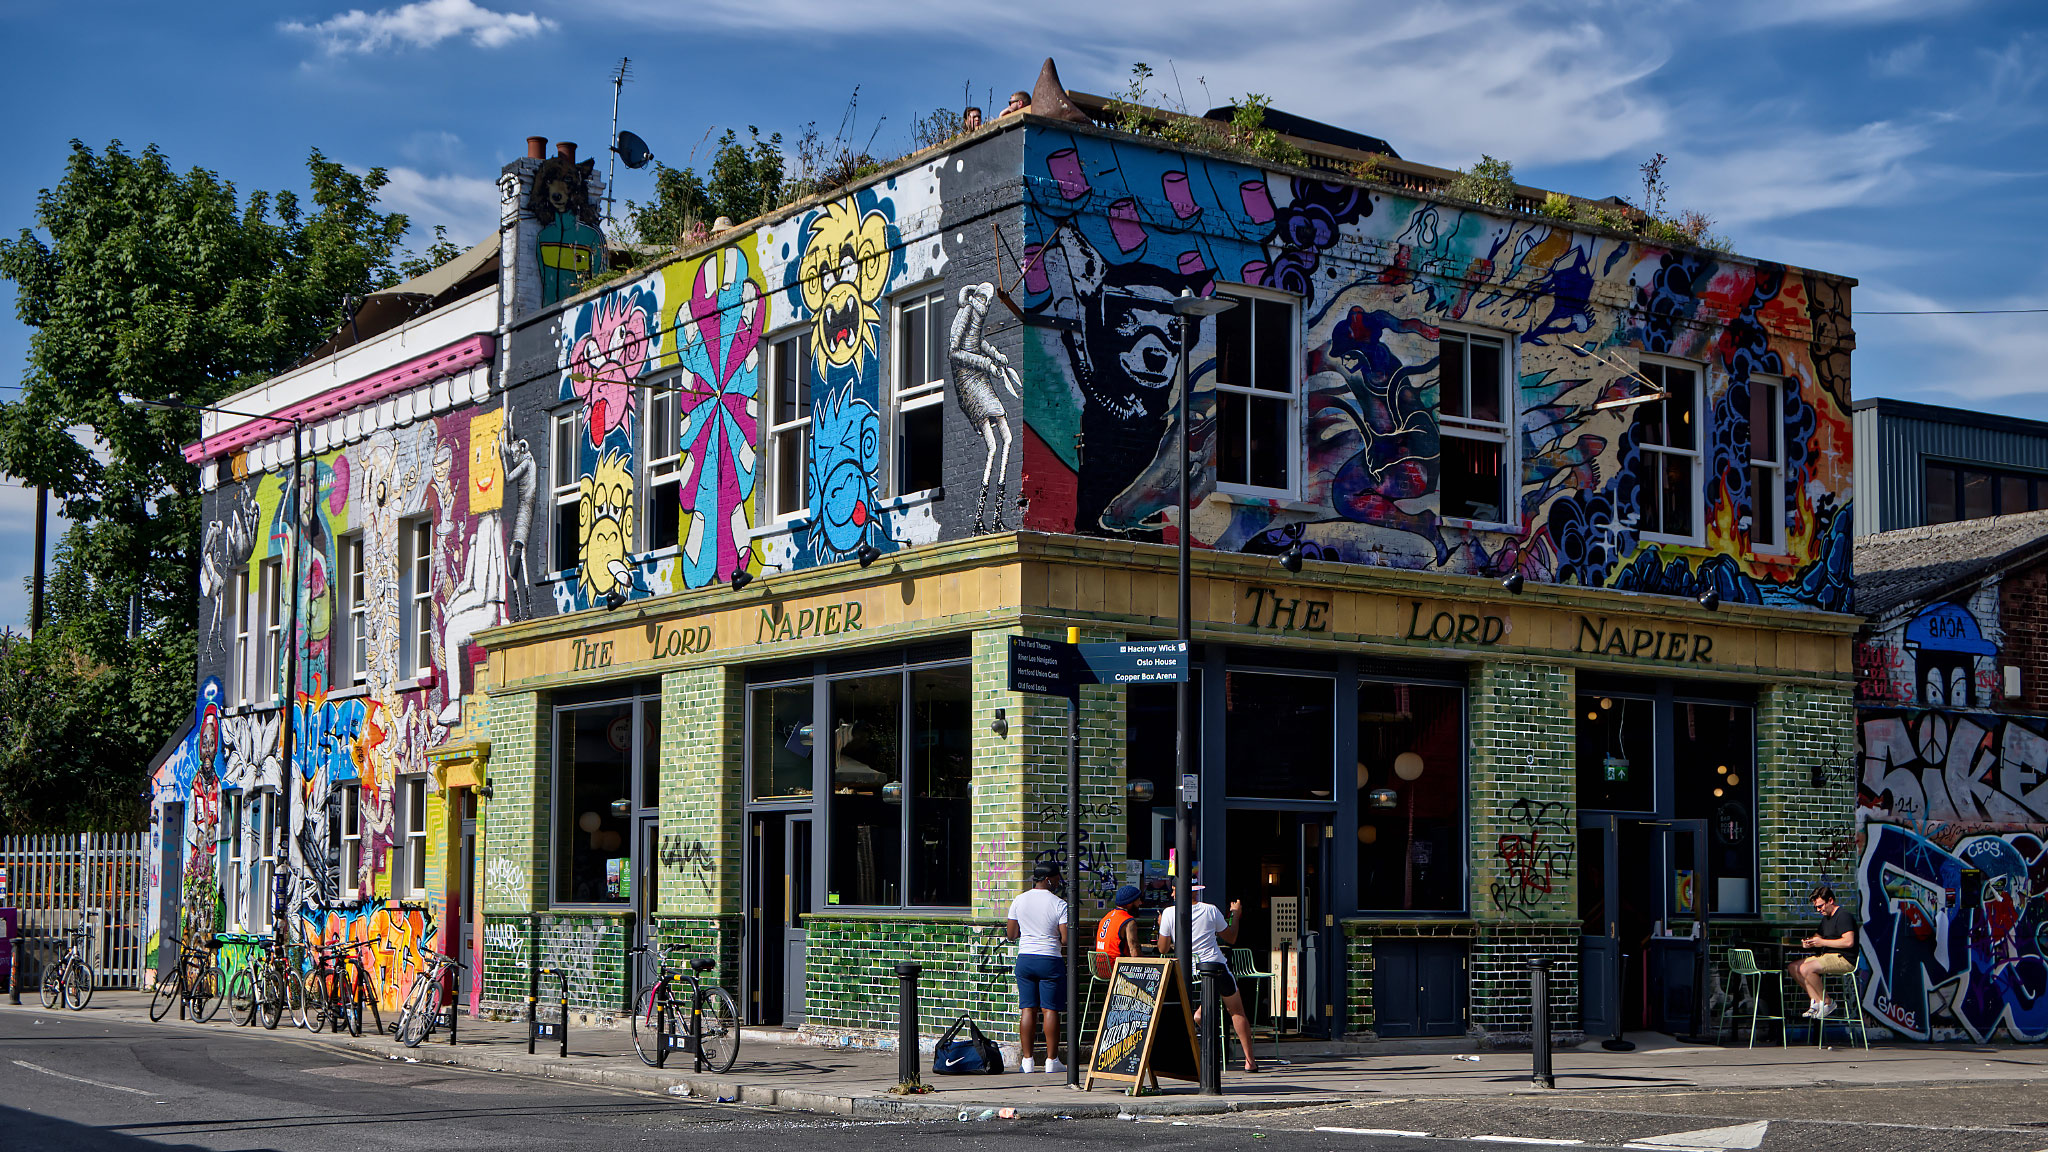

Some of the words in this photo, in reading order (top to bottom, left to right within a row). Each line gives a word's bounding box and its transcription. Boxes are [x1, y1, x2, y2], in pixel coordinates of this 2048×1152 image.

[1245, 587, 1330, 632] THE
[1405, 602, 1503, 645] LORD
[1574, 615, 1714, 663] NAPIER
[572, 637, 613, 671] THE
[652, 624, 711, 659] LORD
[755, 601, 863, 645] NAPIER
[1127, 645, 1157, 653] Hackney
[1158, 644, 1176, 652] Wick
[1037, 656, 1058, 666] Navigation
[1136, 658, 1153, 666] Oslo
[1154, 658, 1177, 666] House
[1115, 673, 1140, 682] Copper
[1141, 672, 1155, 680] Box
[1156, 672, 1177, 680] Arena
